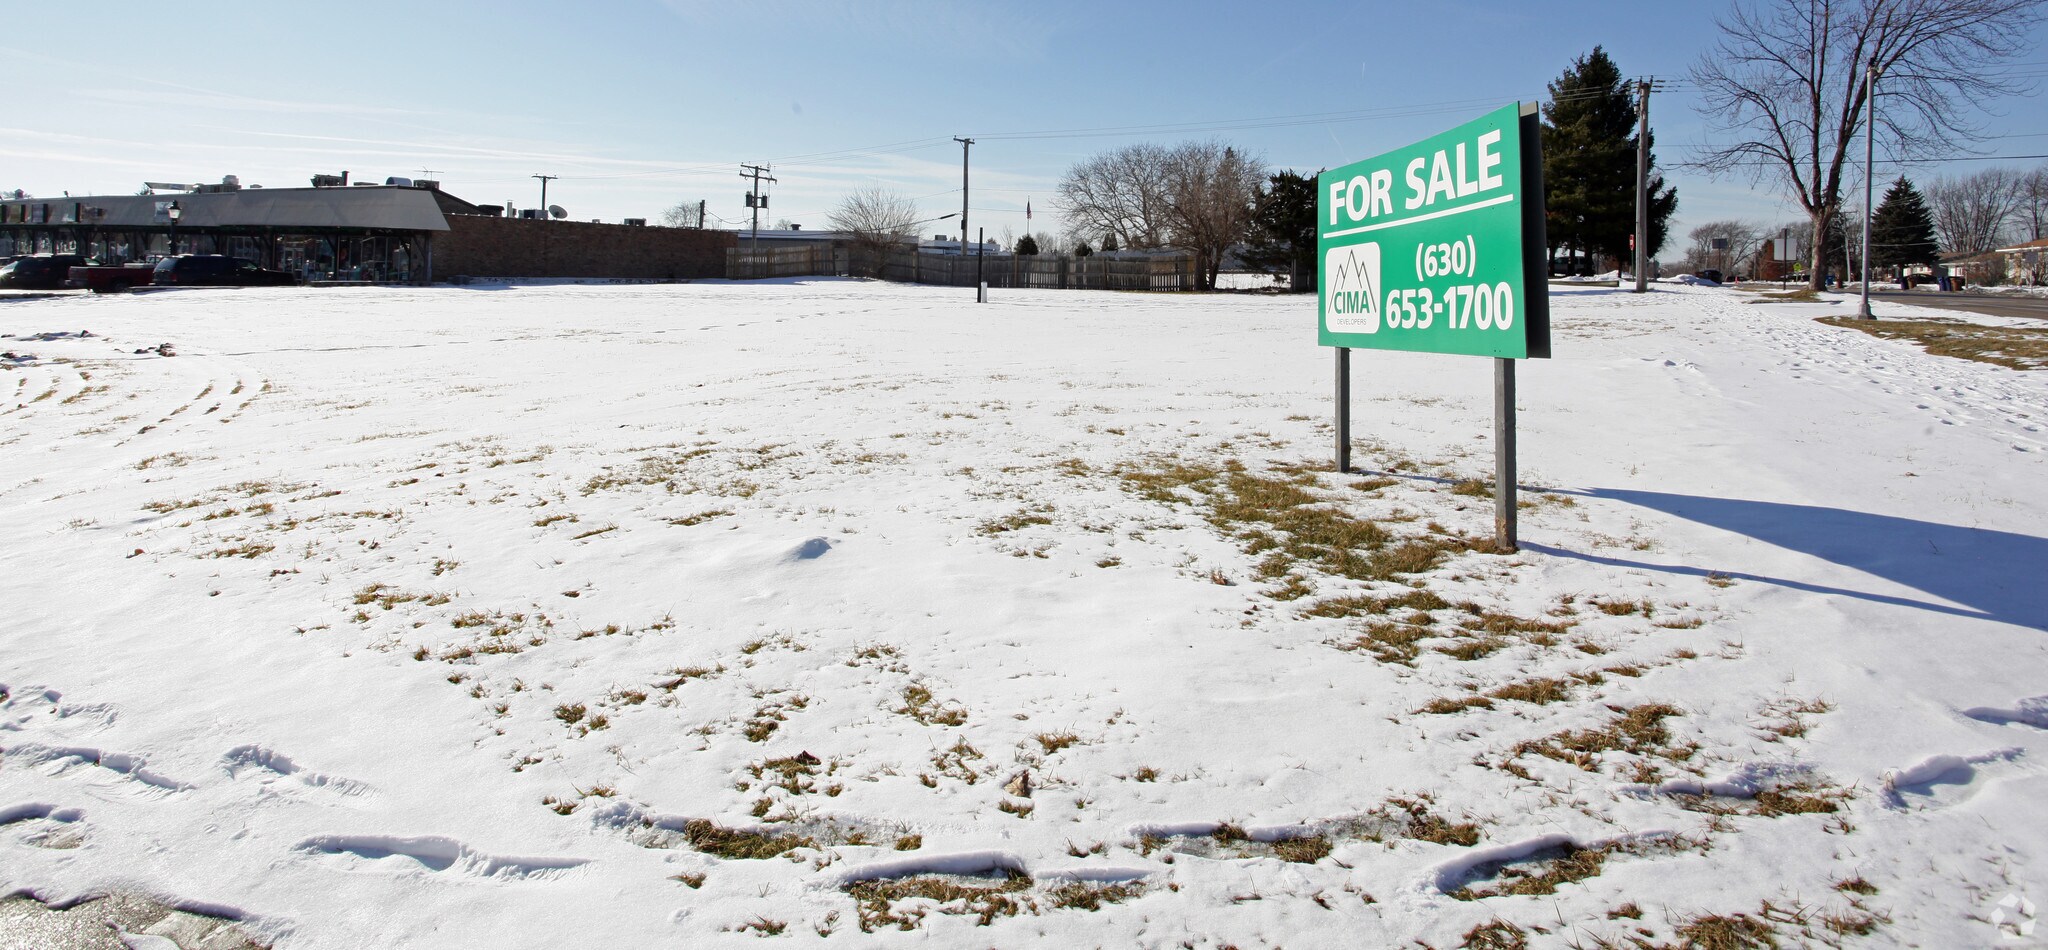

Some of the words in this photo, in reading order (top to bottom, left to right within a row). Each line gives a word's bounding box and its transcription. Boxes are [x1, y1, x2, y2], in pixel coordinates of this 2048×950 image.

[1330, 168, 1393, 226] FOR
[1405, 129, 1502, 210] SALE
[1415, 234, 1476, 282] (630)
[1334, 290, 1370, 314] CIMA
[1385, 281, 1514, 331] 653-1700
